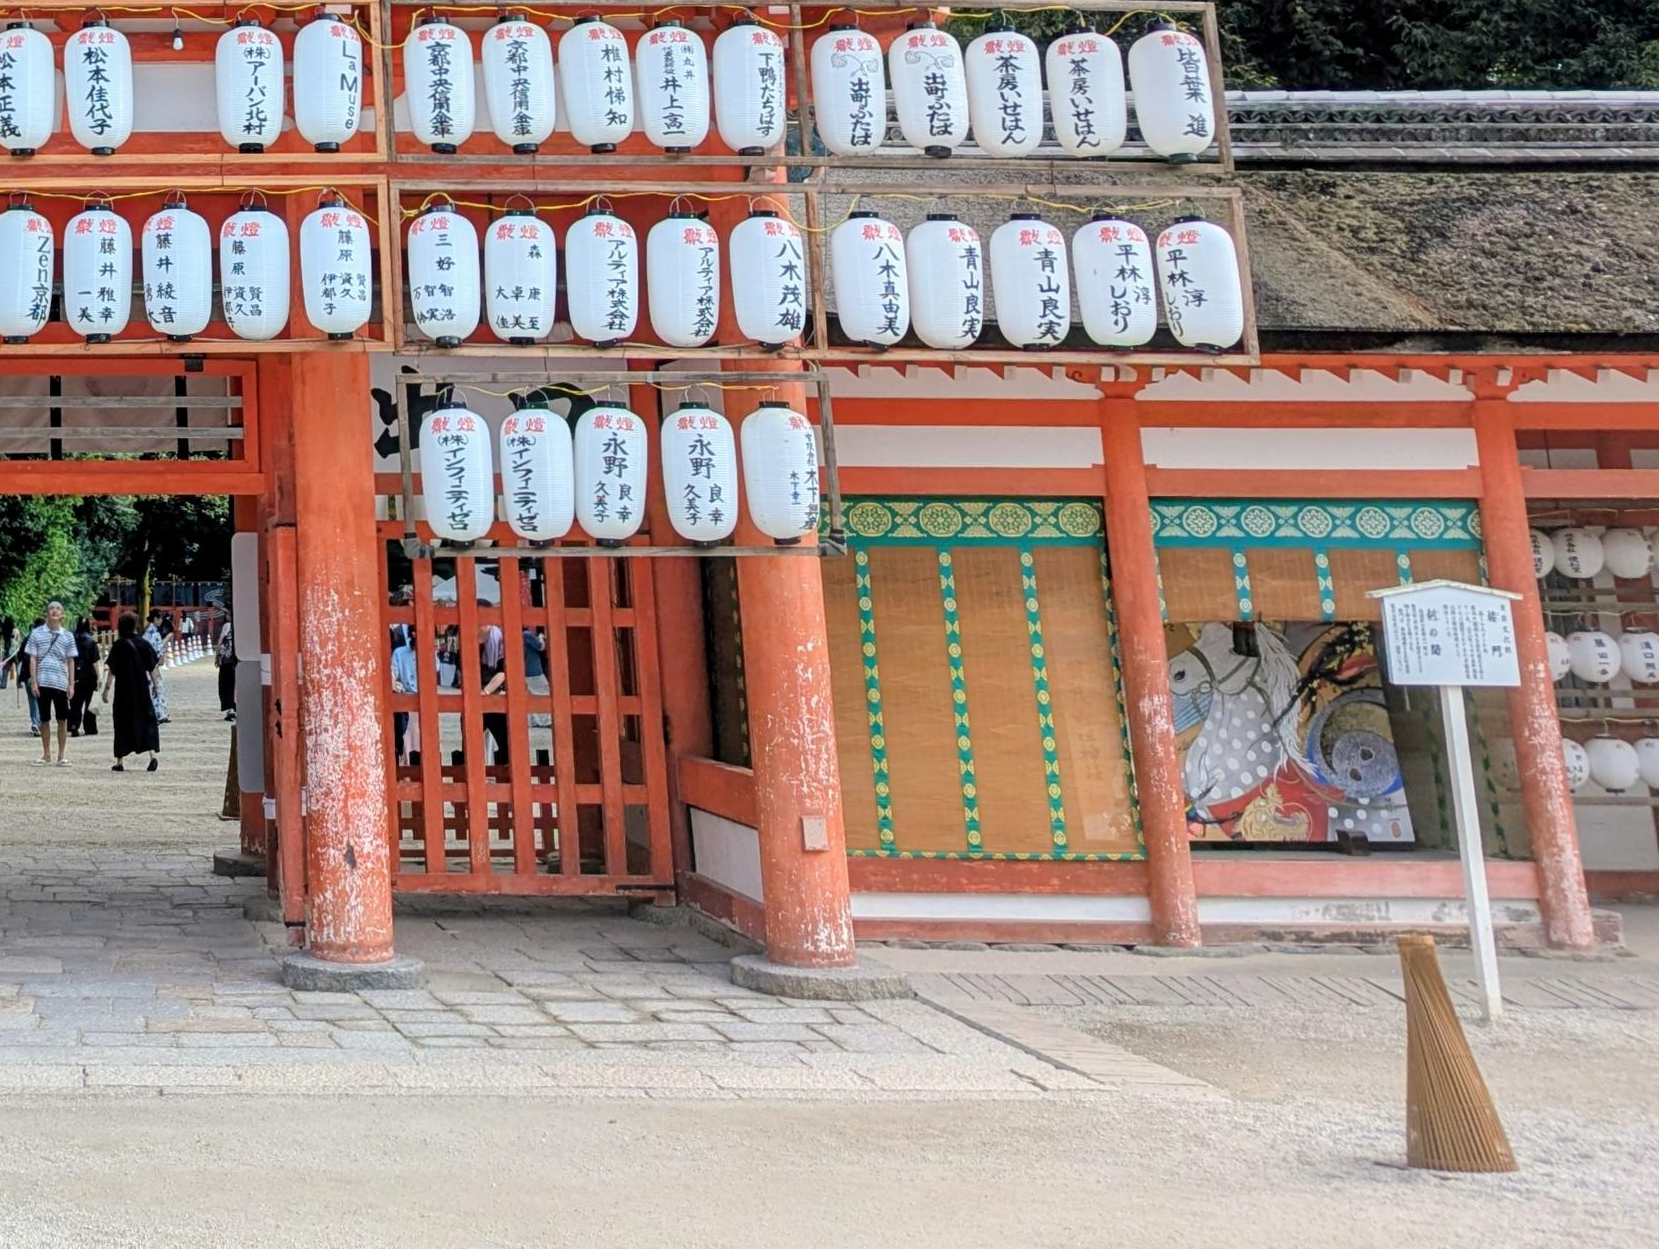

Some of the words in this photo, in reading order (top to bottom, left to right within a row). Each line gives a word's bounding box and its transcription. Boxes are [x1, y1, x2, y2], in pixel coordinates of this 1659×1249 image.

[83, 47, 112, 135] 松本佳代子
[426, 41, 453, 138] 京都中央信用金庫
[507, 40, 533, 136] 京都中央信用金庫
[850, 78, 873, 147] 出町ふたば
[924, 73, 953, 136] 出町ふたば
[995, 55, 1025, 144] 茶房いせはん
[1070, 58, 1100, 148] 茶房いせはん
[603, 240, 629, 331] アルティア株式会社
[691, 248, 717, 339] アルティア株式会社
[775, 238, 803, 330] 八木茂雄
[873, 244, 900, 337] 八木真由美
[959, 244, 983, 340] 青山良実
[1033, 248, 1066, 343] 青山良実
[603, 432, 628, 478] 永野
[689, 434, 715, 479] 永野
